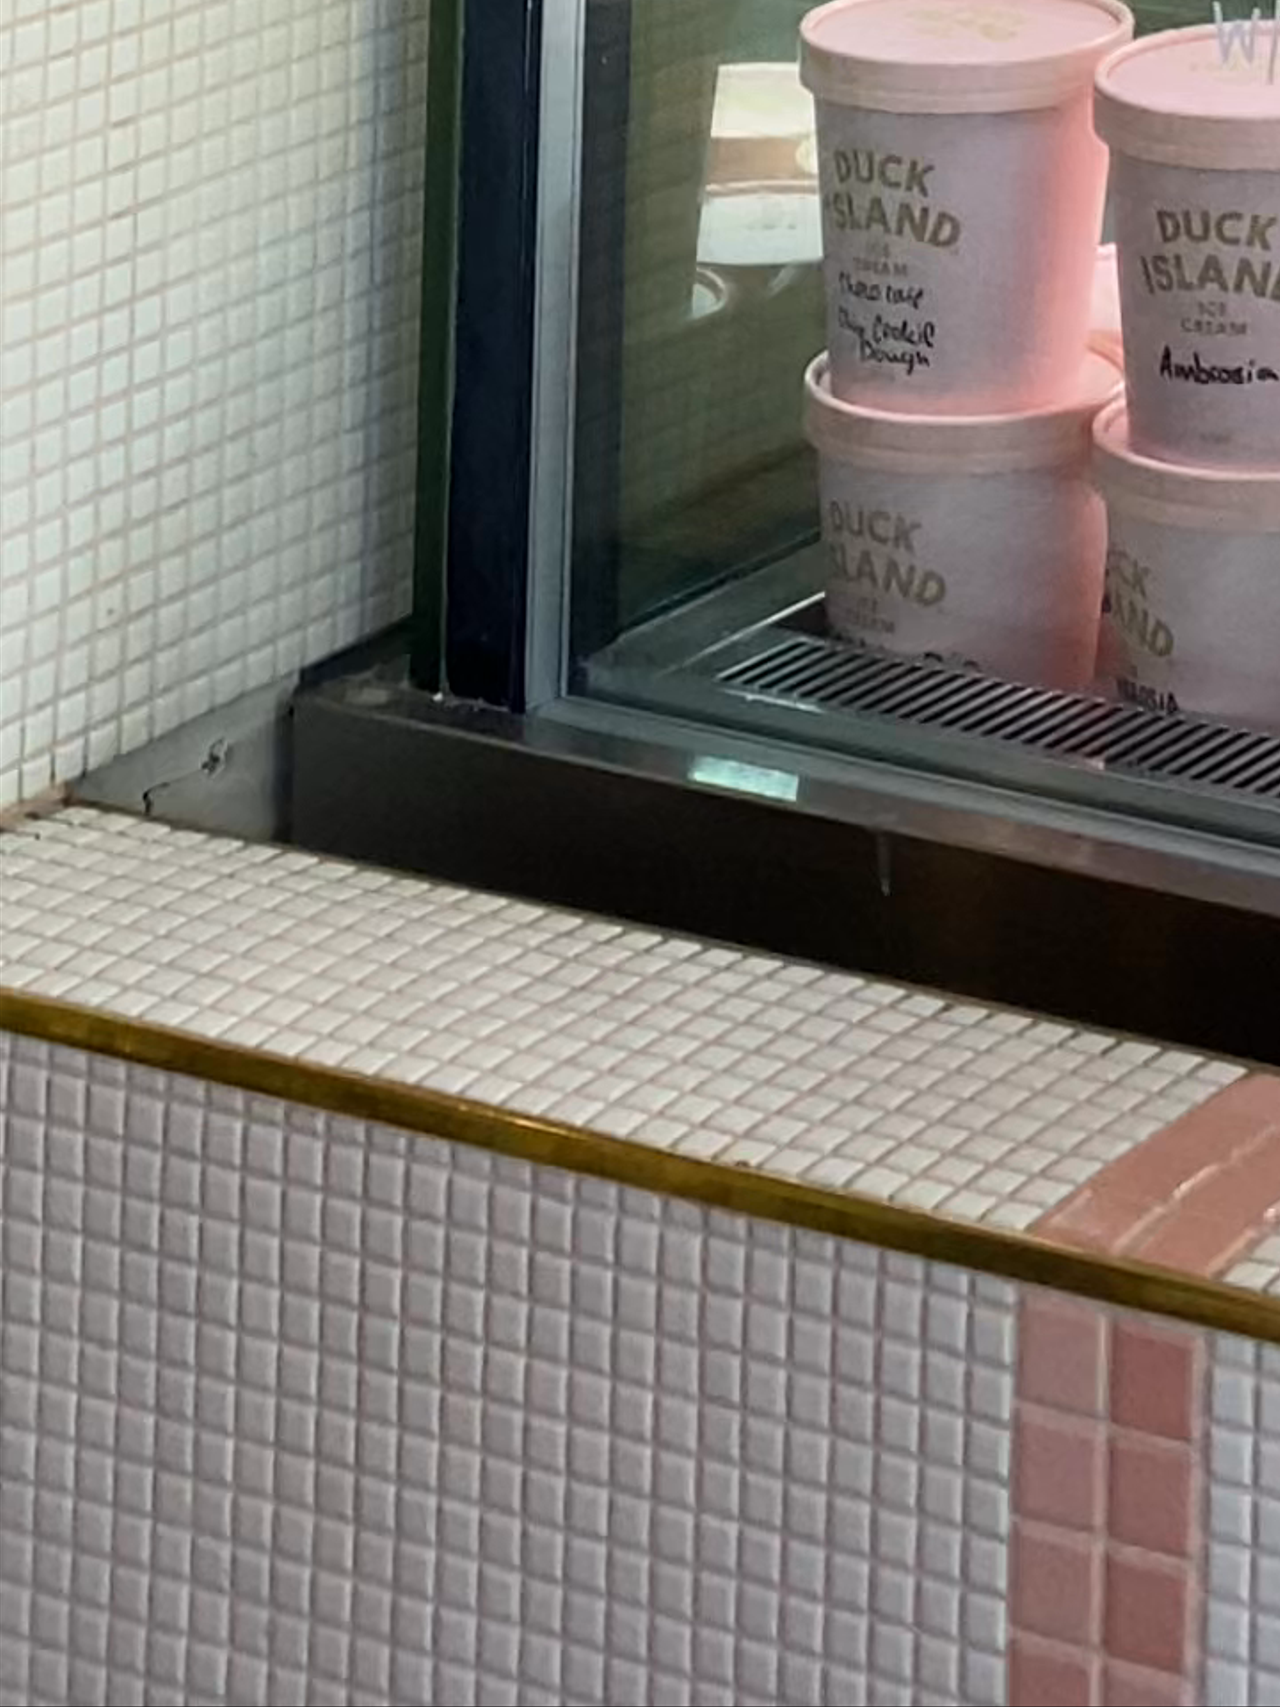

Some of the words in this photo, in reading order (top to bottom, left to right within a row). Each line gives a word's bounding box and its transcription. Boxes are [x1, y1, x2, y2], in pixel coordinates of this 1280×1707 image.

[833, 147, 935, 199] DUCK
[1155, 208, 1280, 252] DUCK
[829, 499, 923, 558] DUCK
